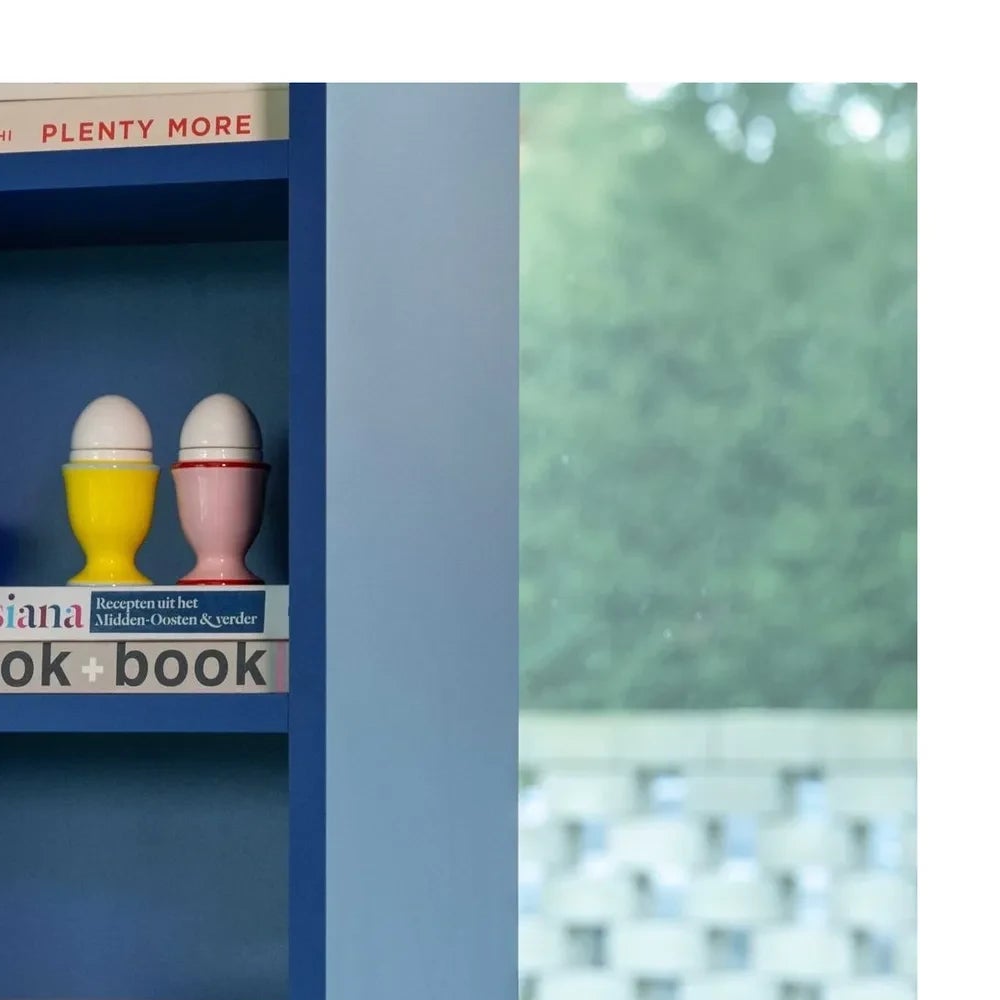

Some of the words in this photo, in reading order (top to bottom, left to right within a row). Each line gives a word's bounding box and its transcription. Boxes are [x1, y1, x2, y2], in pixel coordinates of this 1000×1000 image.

[41, 119, 155, 143] PLENTY
[168, 114, 252, 138] MORE
[96, 597, 156, 612] Recepten
[157, 597, 176, 609] uit
[177, 596, 199, 609] het
[95, 613, 198, 627] Midden-Oosten
[216, 612, 258, 625] verder
[115, 640, 268, 687] book
